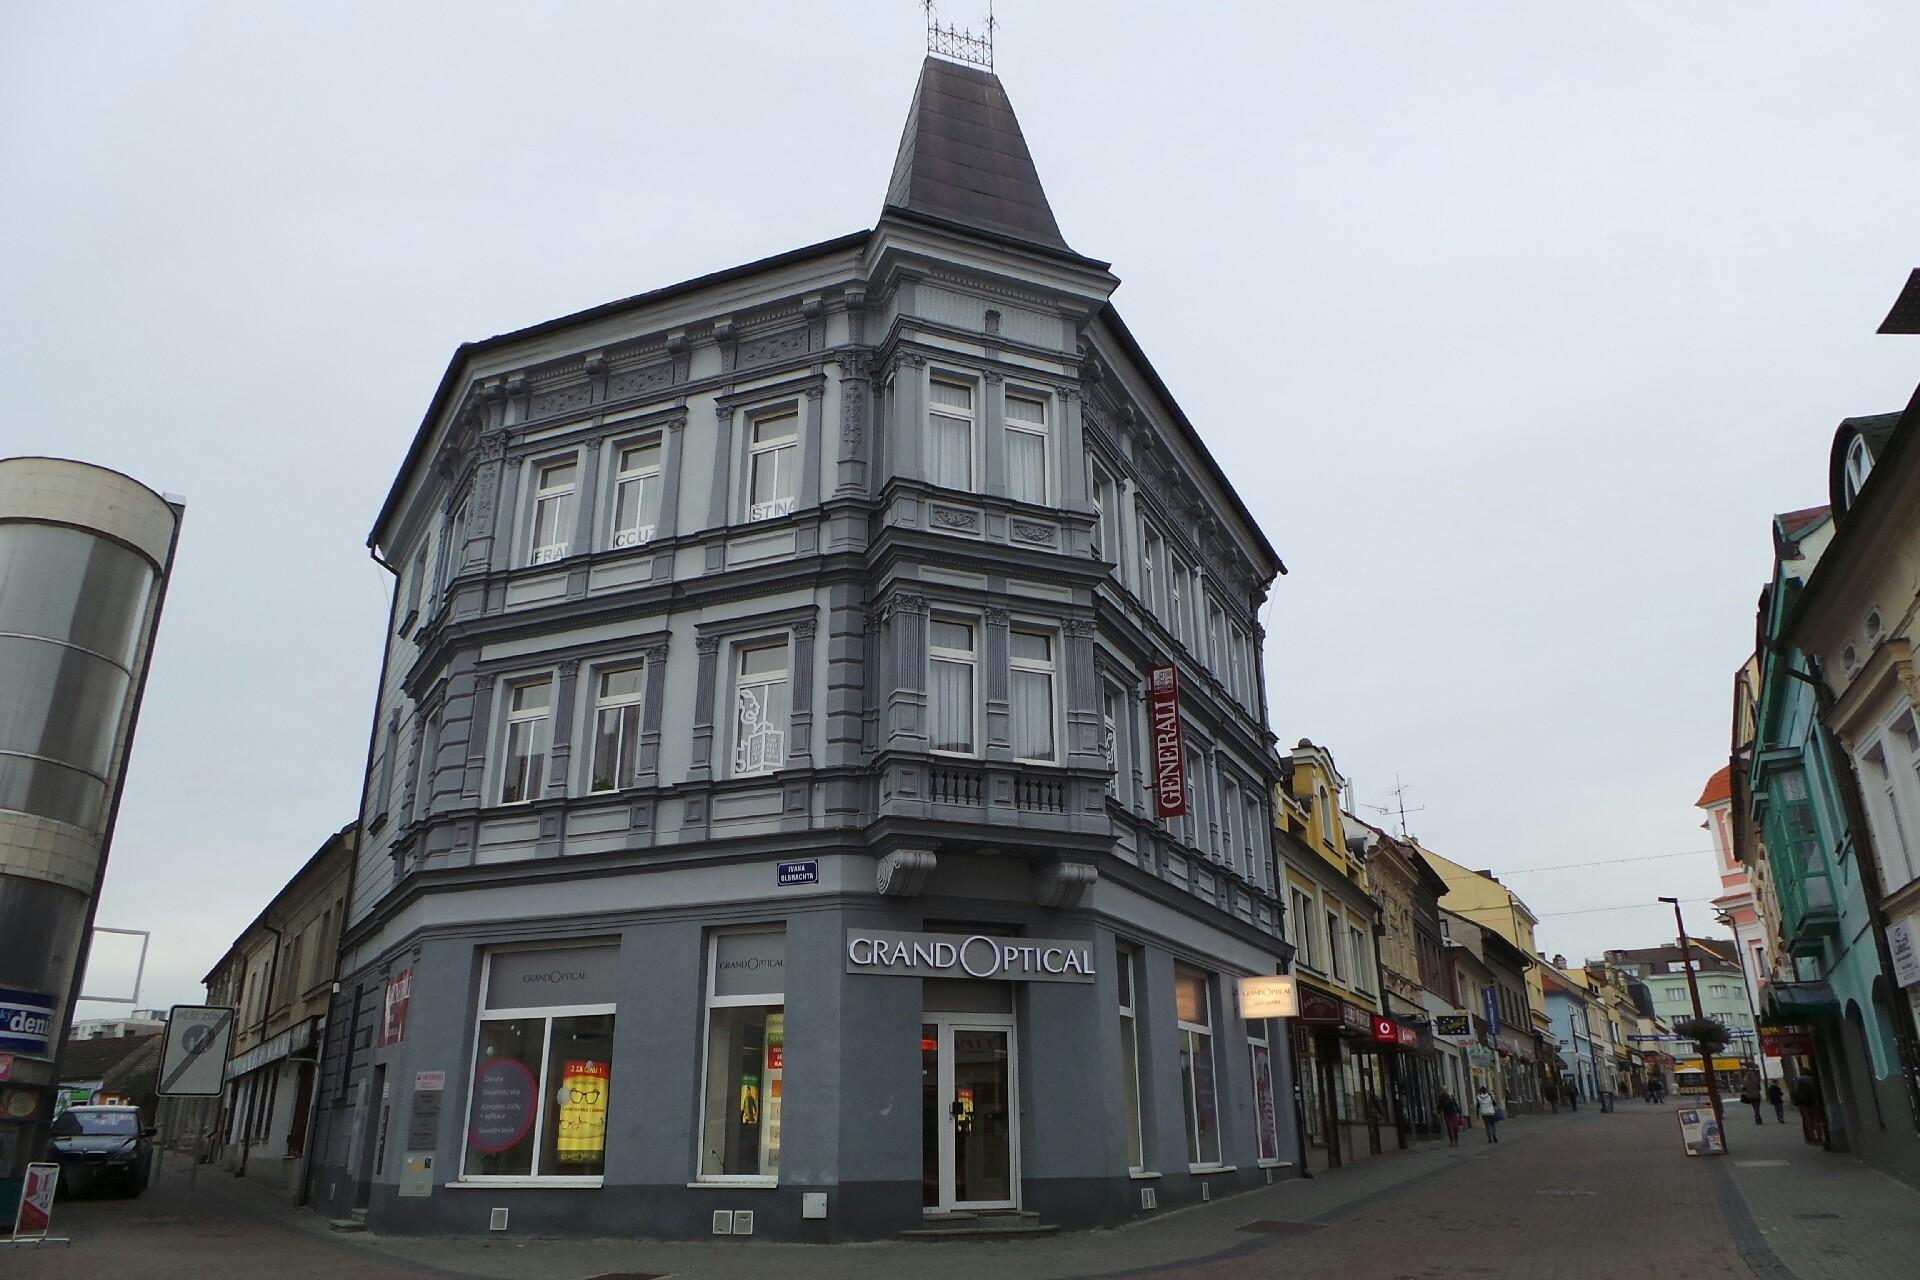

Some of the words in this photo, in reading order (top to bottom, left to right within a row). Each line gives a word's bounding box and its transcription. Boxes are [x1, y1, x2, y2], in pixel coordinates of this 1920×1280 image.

[1154, 699, 1182, 809] GENERALI
[788, 864, 806, 873] IVANA
[780, 872, 814, 882] OLBRACHTA
